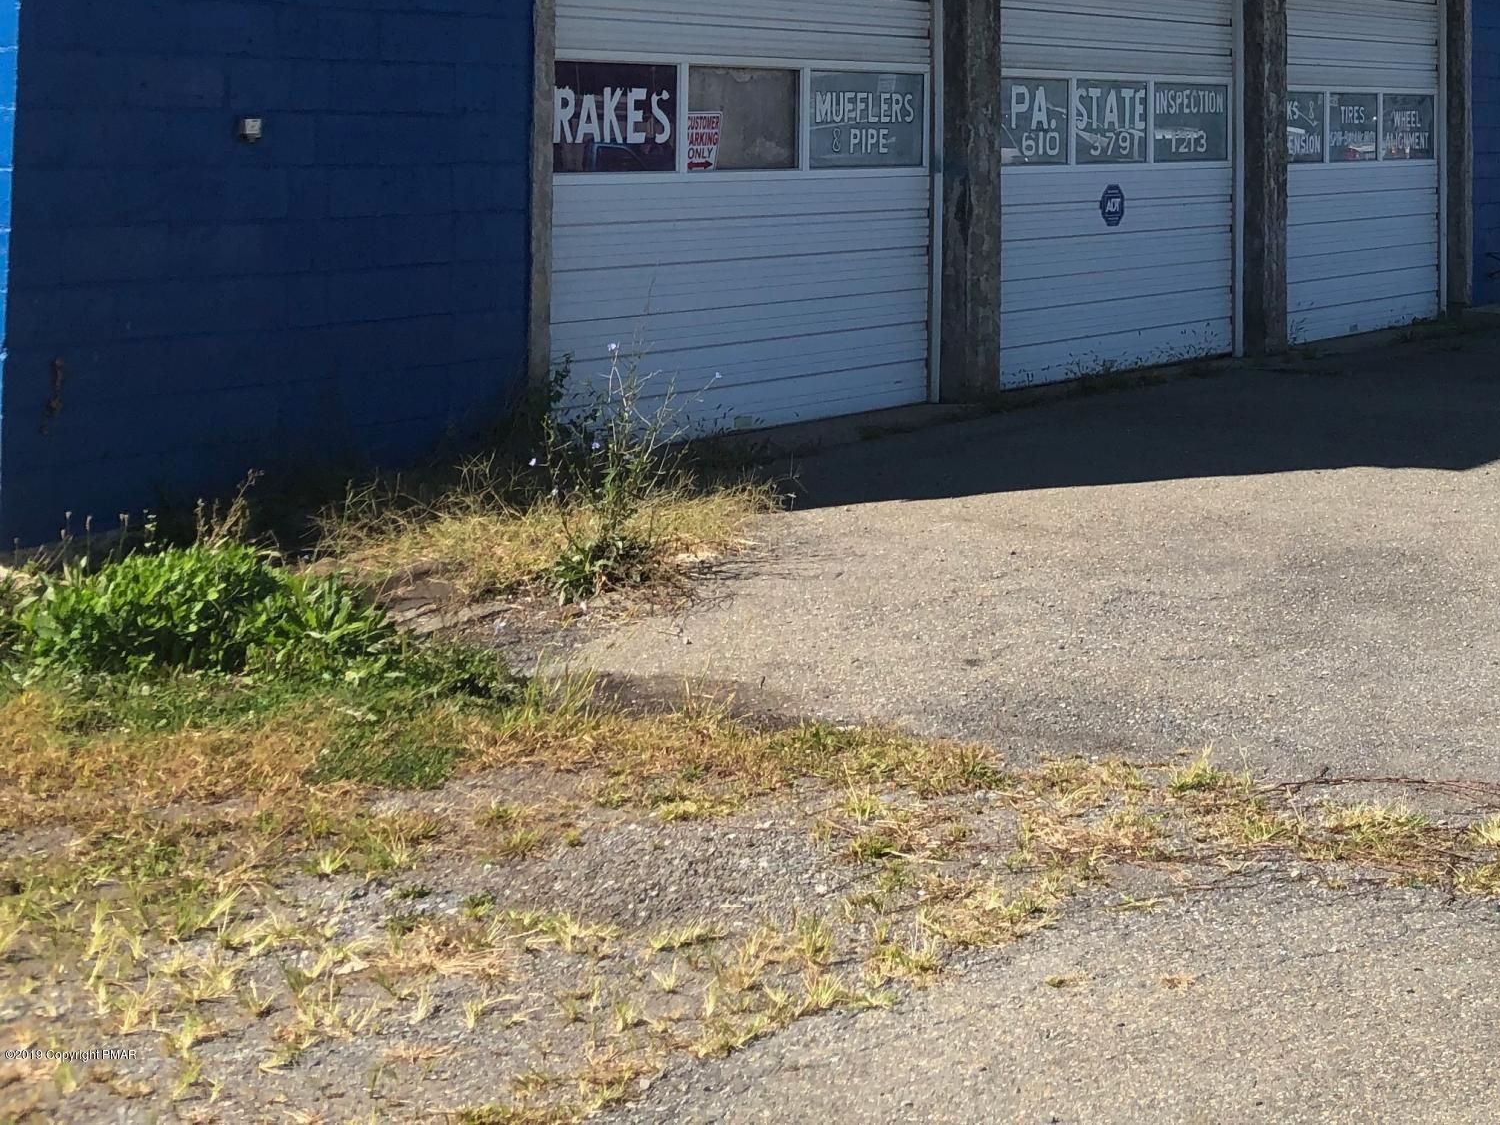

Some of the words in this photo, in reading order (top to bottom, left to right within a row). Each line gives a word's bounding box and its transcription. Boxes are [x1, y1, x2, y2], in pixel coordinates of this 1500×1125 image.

[815, 90, 915, 125] MUFFLERS
[1010, 84, 1057, 131] PA.
[1074, 86, 1147, 131] STATE
[1155, 89, 1224, 115] INSPECTION
[1340, 105, 1365, 125] TIRES
[1393, 110, 1421, 128] WHEEL
[688, 132, 719, 147] ARKING
[848, 127, 890, 155] PIPE
[1021, 131, 1060, 157] 610
[1170, 130, 1207, 154] 1213
[688, 147, 713, 160] ONLY
[1104, 198, 1121, 213] ADT
